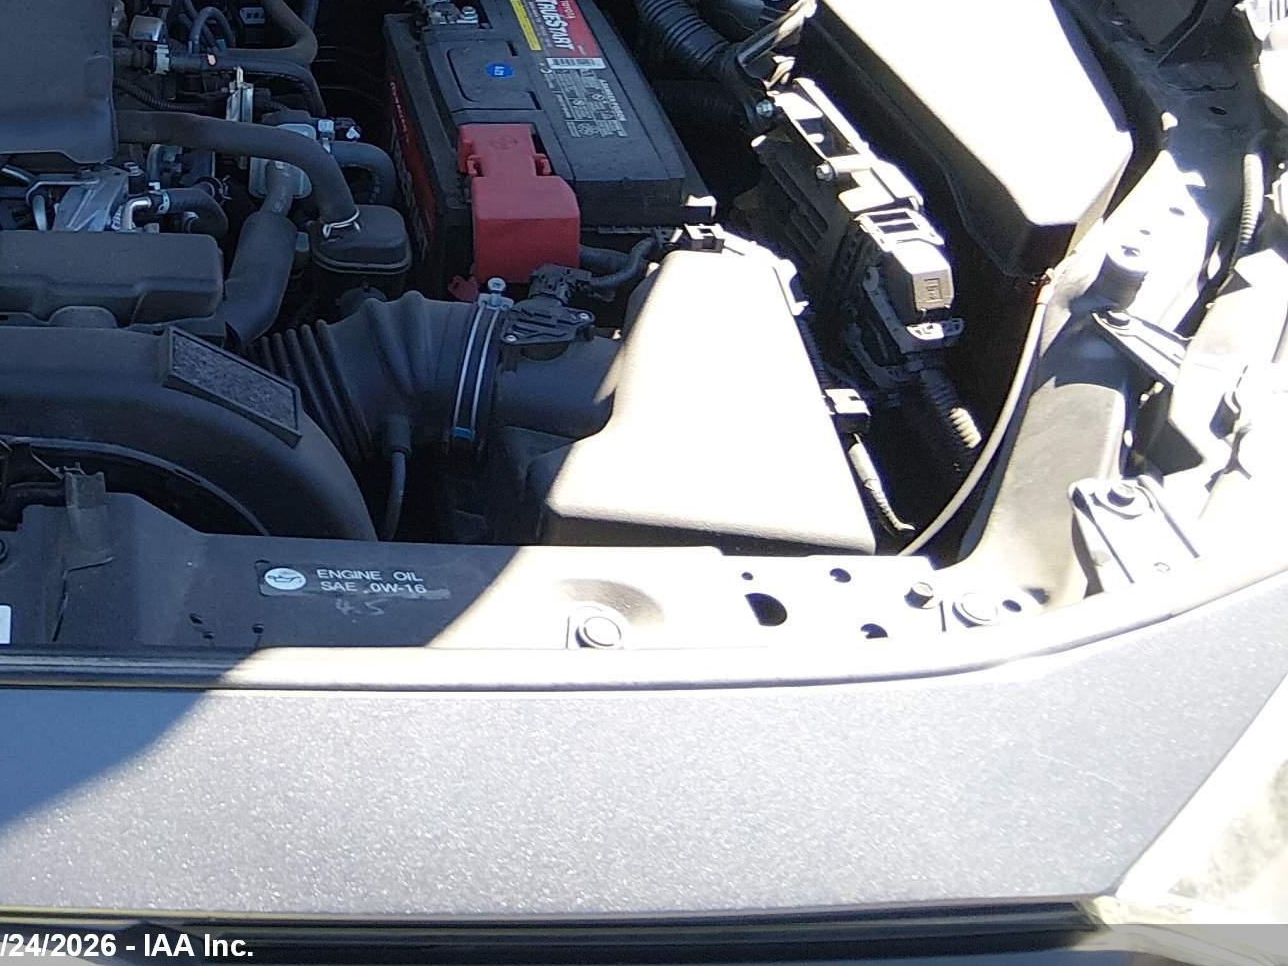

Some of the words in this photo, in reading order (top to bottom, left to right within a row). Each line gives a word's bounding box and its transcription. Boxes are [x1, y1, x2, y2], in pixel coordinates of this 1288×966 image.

[561, 0, 576, 19] TOYOTA
[317, 569, 382, 580] ENGINE
[394, 571, 423, 581] OIL
[321, 582, 357, 592] SAE
